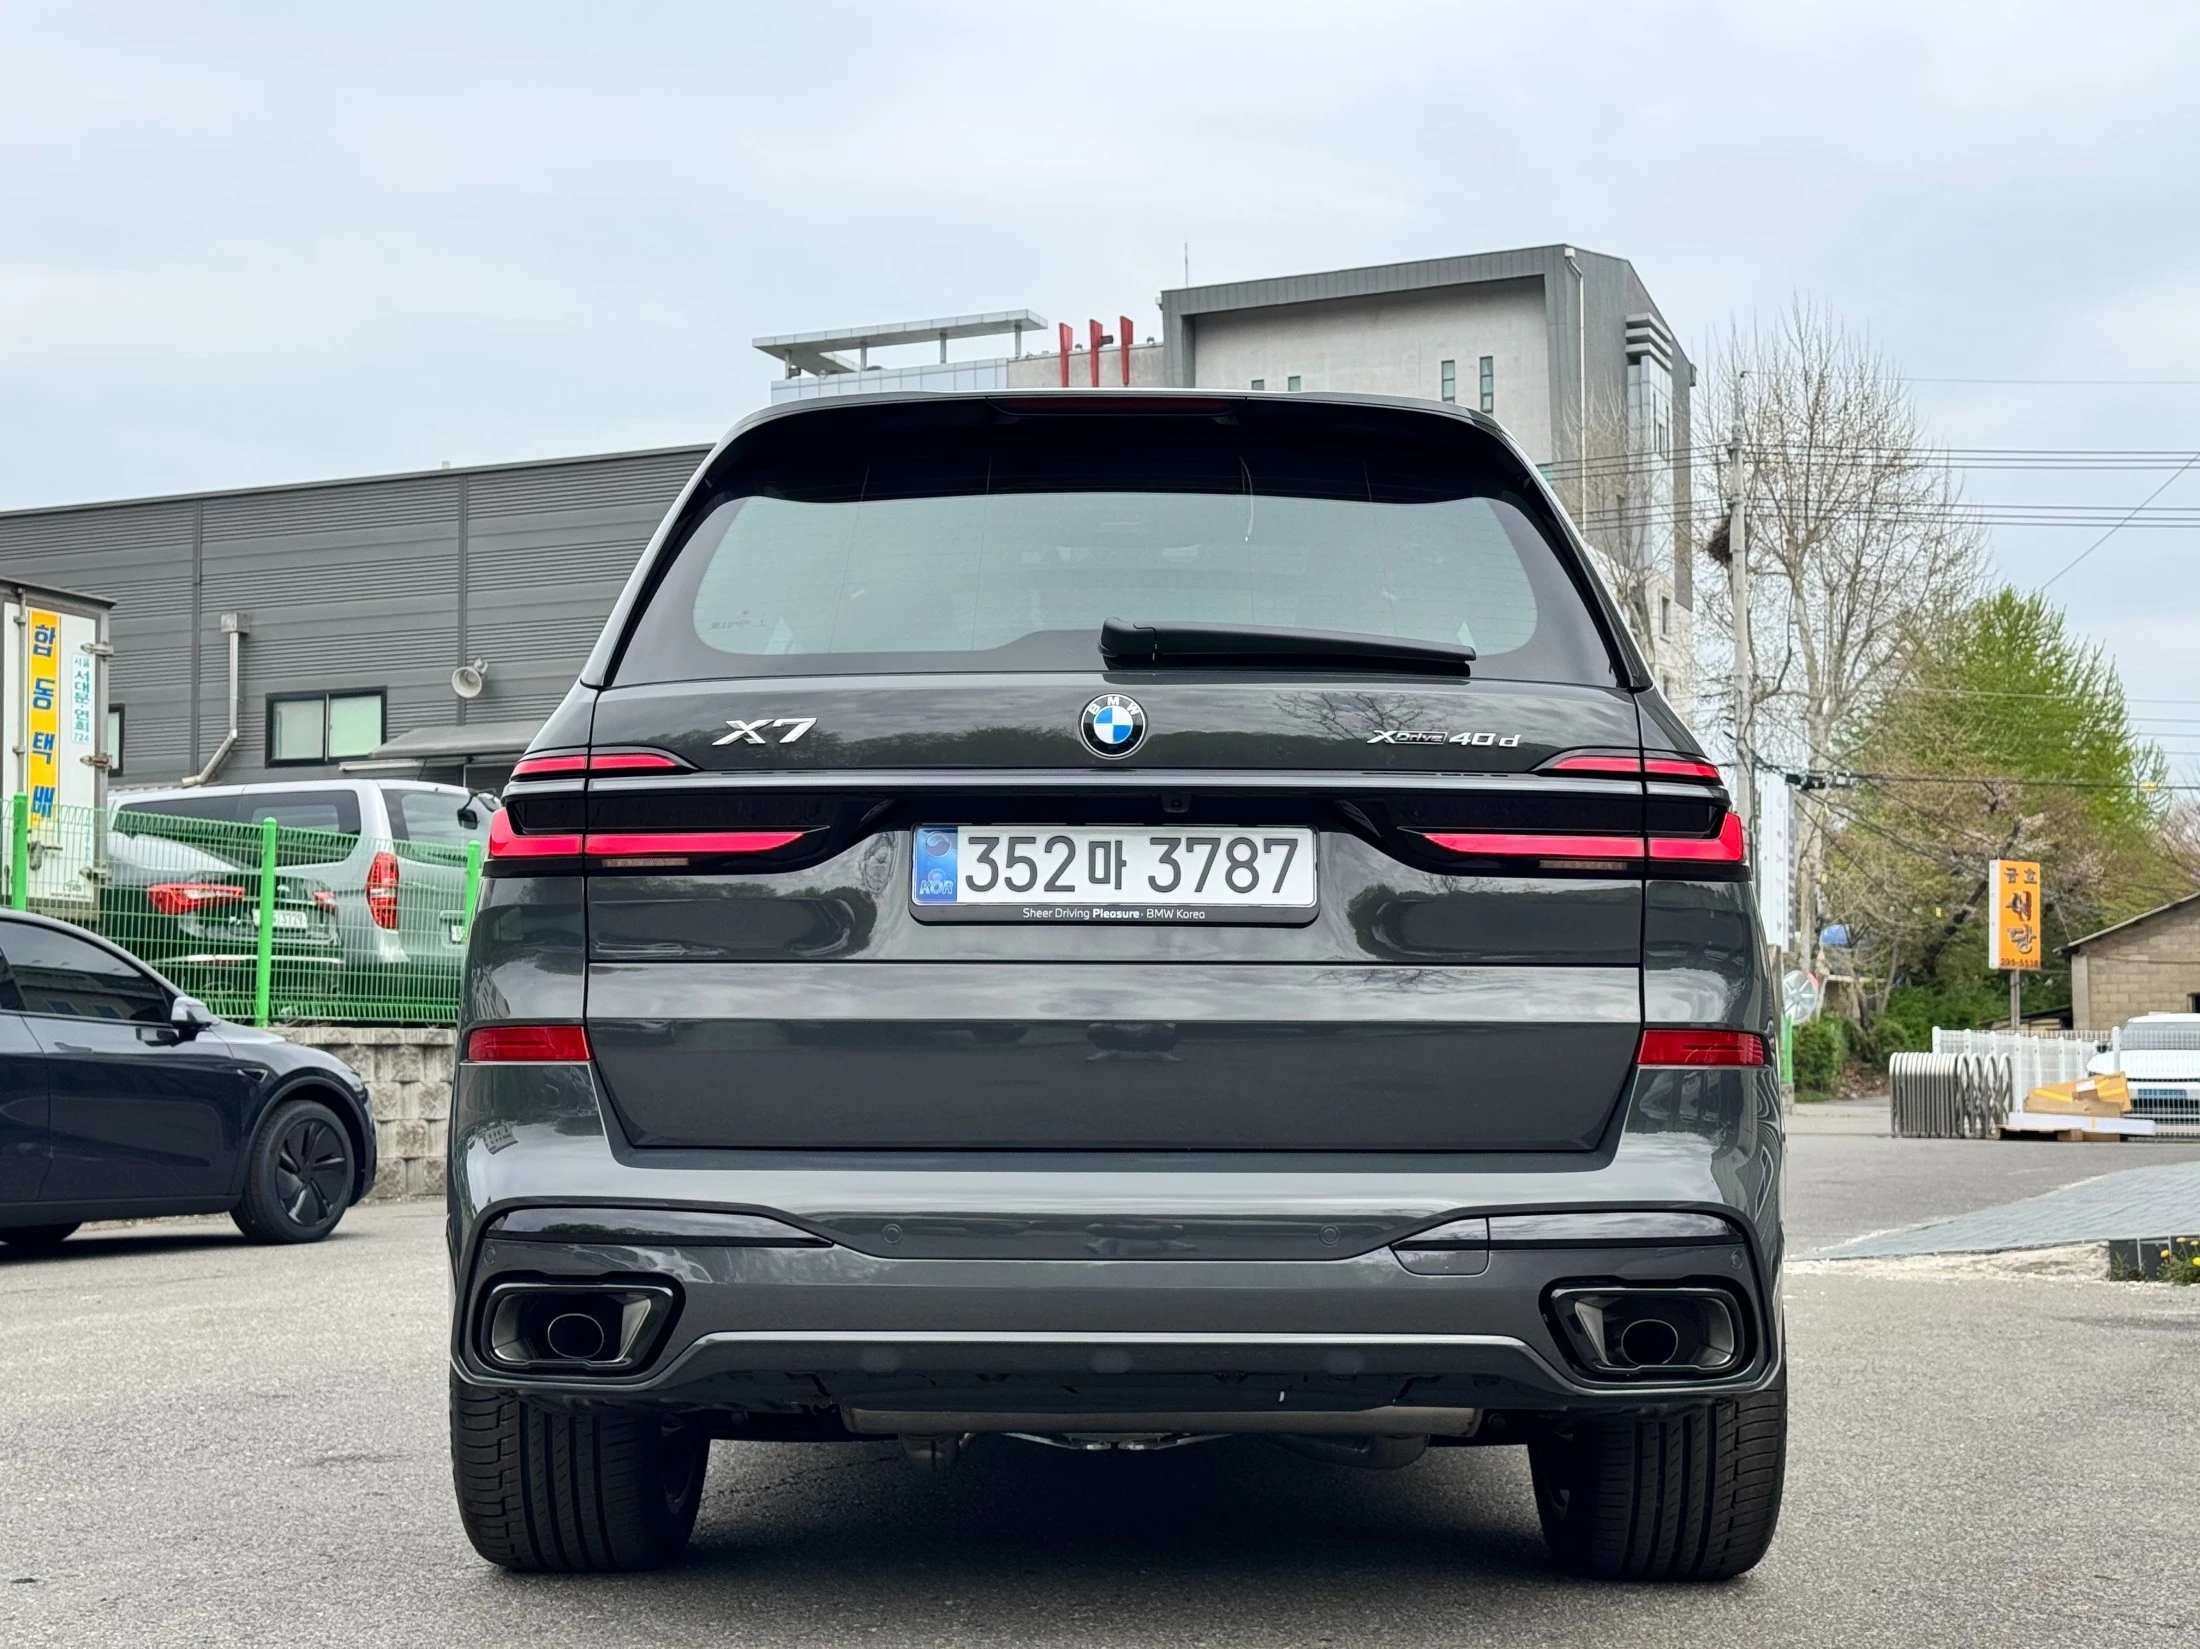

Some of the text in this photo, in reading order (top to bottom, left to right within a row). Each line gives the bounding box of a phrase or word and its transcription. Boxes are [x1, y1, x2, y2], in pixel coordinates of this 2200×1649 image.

[1087, 696, 1140, 716] BMW
[32, 624, 56, 818] 합동택배
[711, 717, 818, 746] X7
[965, 835, 1299, 894] 352마 3787
[919, 880, 954, 895] KOR
[1022, 907, 1053, 919] Sheer
[1054, 908, 1090, 920] Driving
[1146, 909, 1174, 919] BMW
[1176, 909, 1206, 919] Korea
[2005, 890, 2038, 955] 식당
